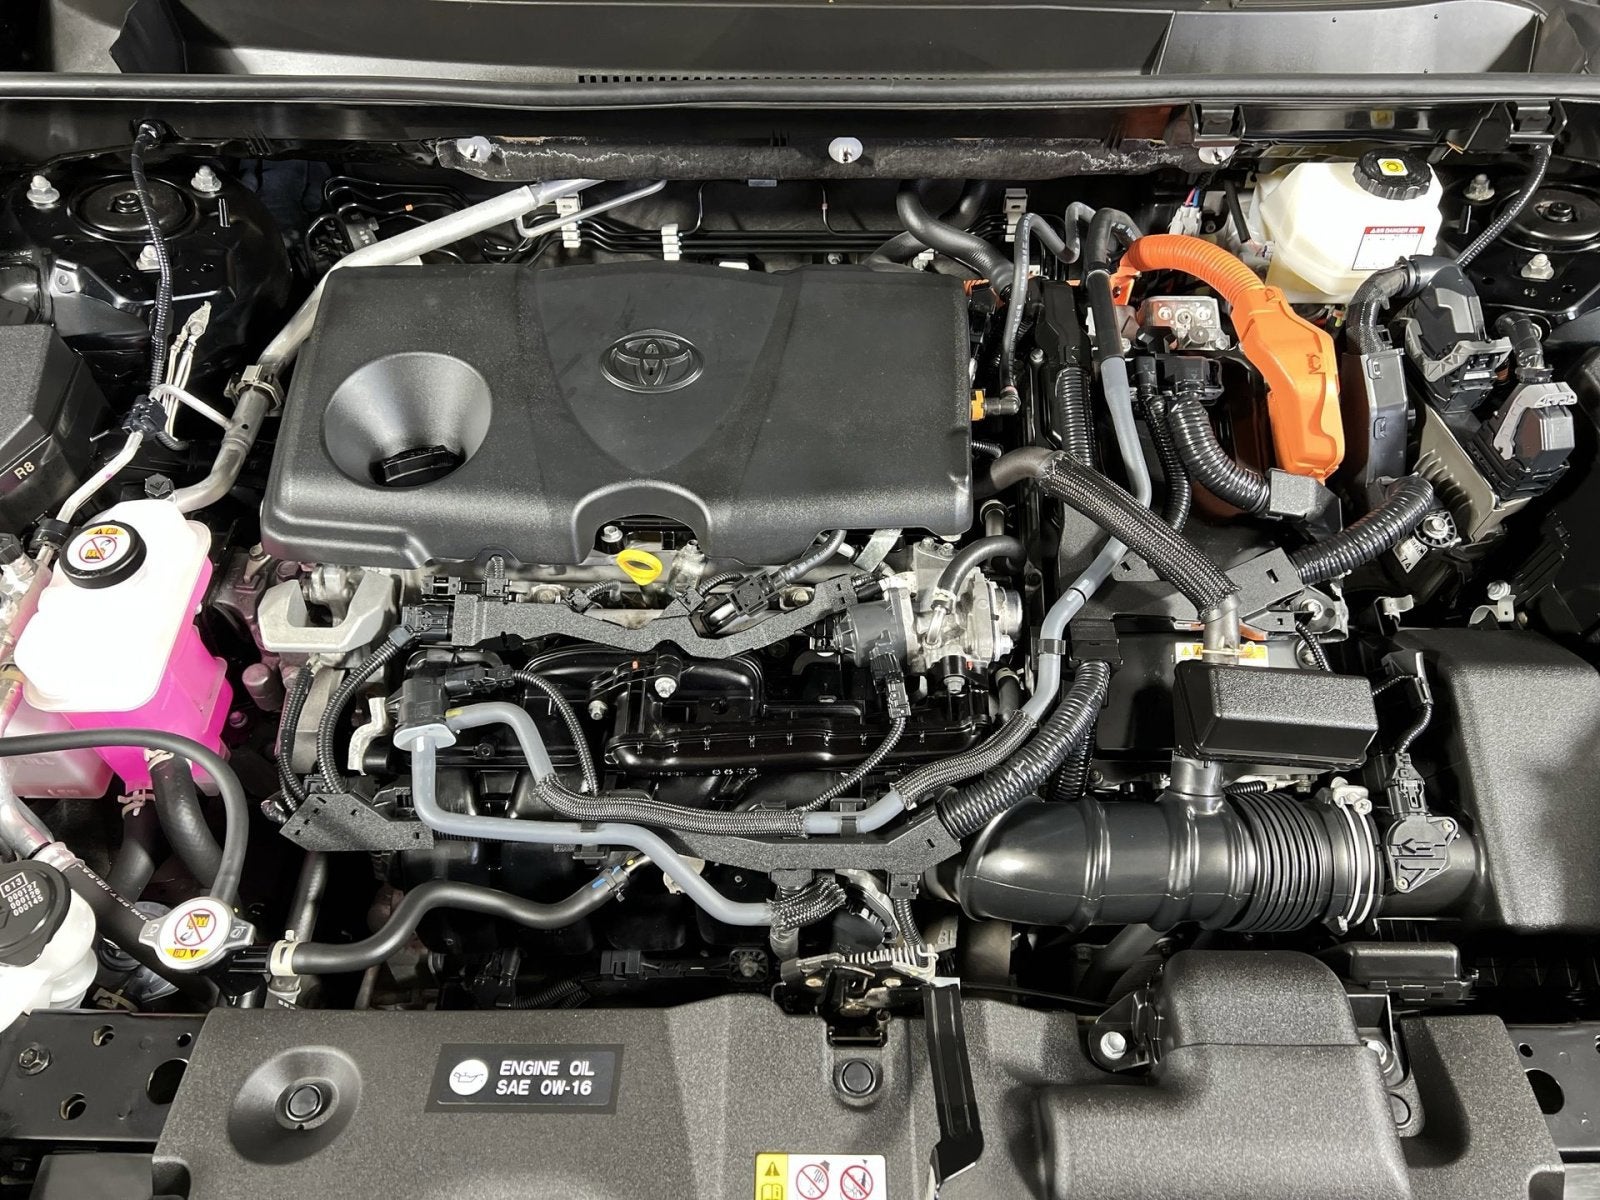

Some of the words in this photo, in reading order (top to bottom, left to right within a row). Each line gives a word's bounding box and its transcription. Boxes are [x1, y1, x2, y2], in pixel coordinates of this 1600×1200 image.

[13, 461, 35, 480] R8
[7, 880, 37, 903] 000127
[13, 894, 44, 916] 000145
[499, 1060, 560, 1076] ENGINE
[569, 1060, 595, 1076] OIL
[495, 1079, 531, 1095] SAE
[540, 1080, 592, 1096] 0W-16
